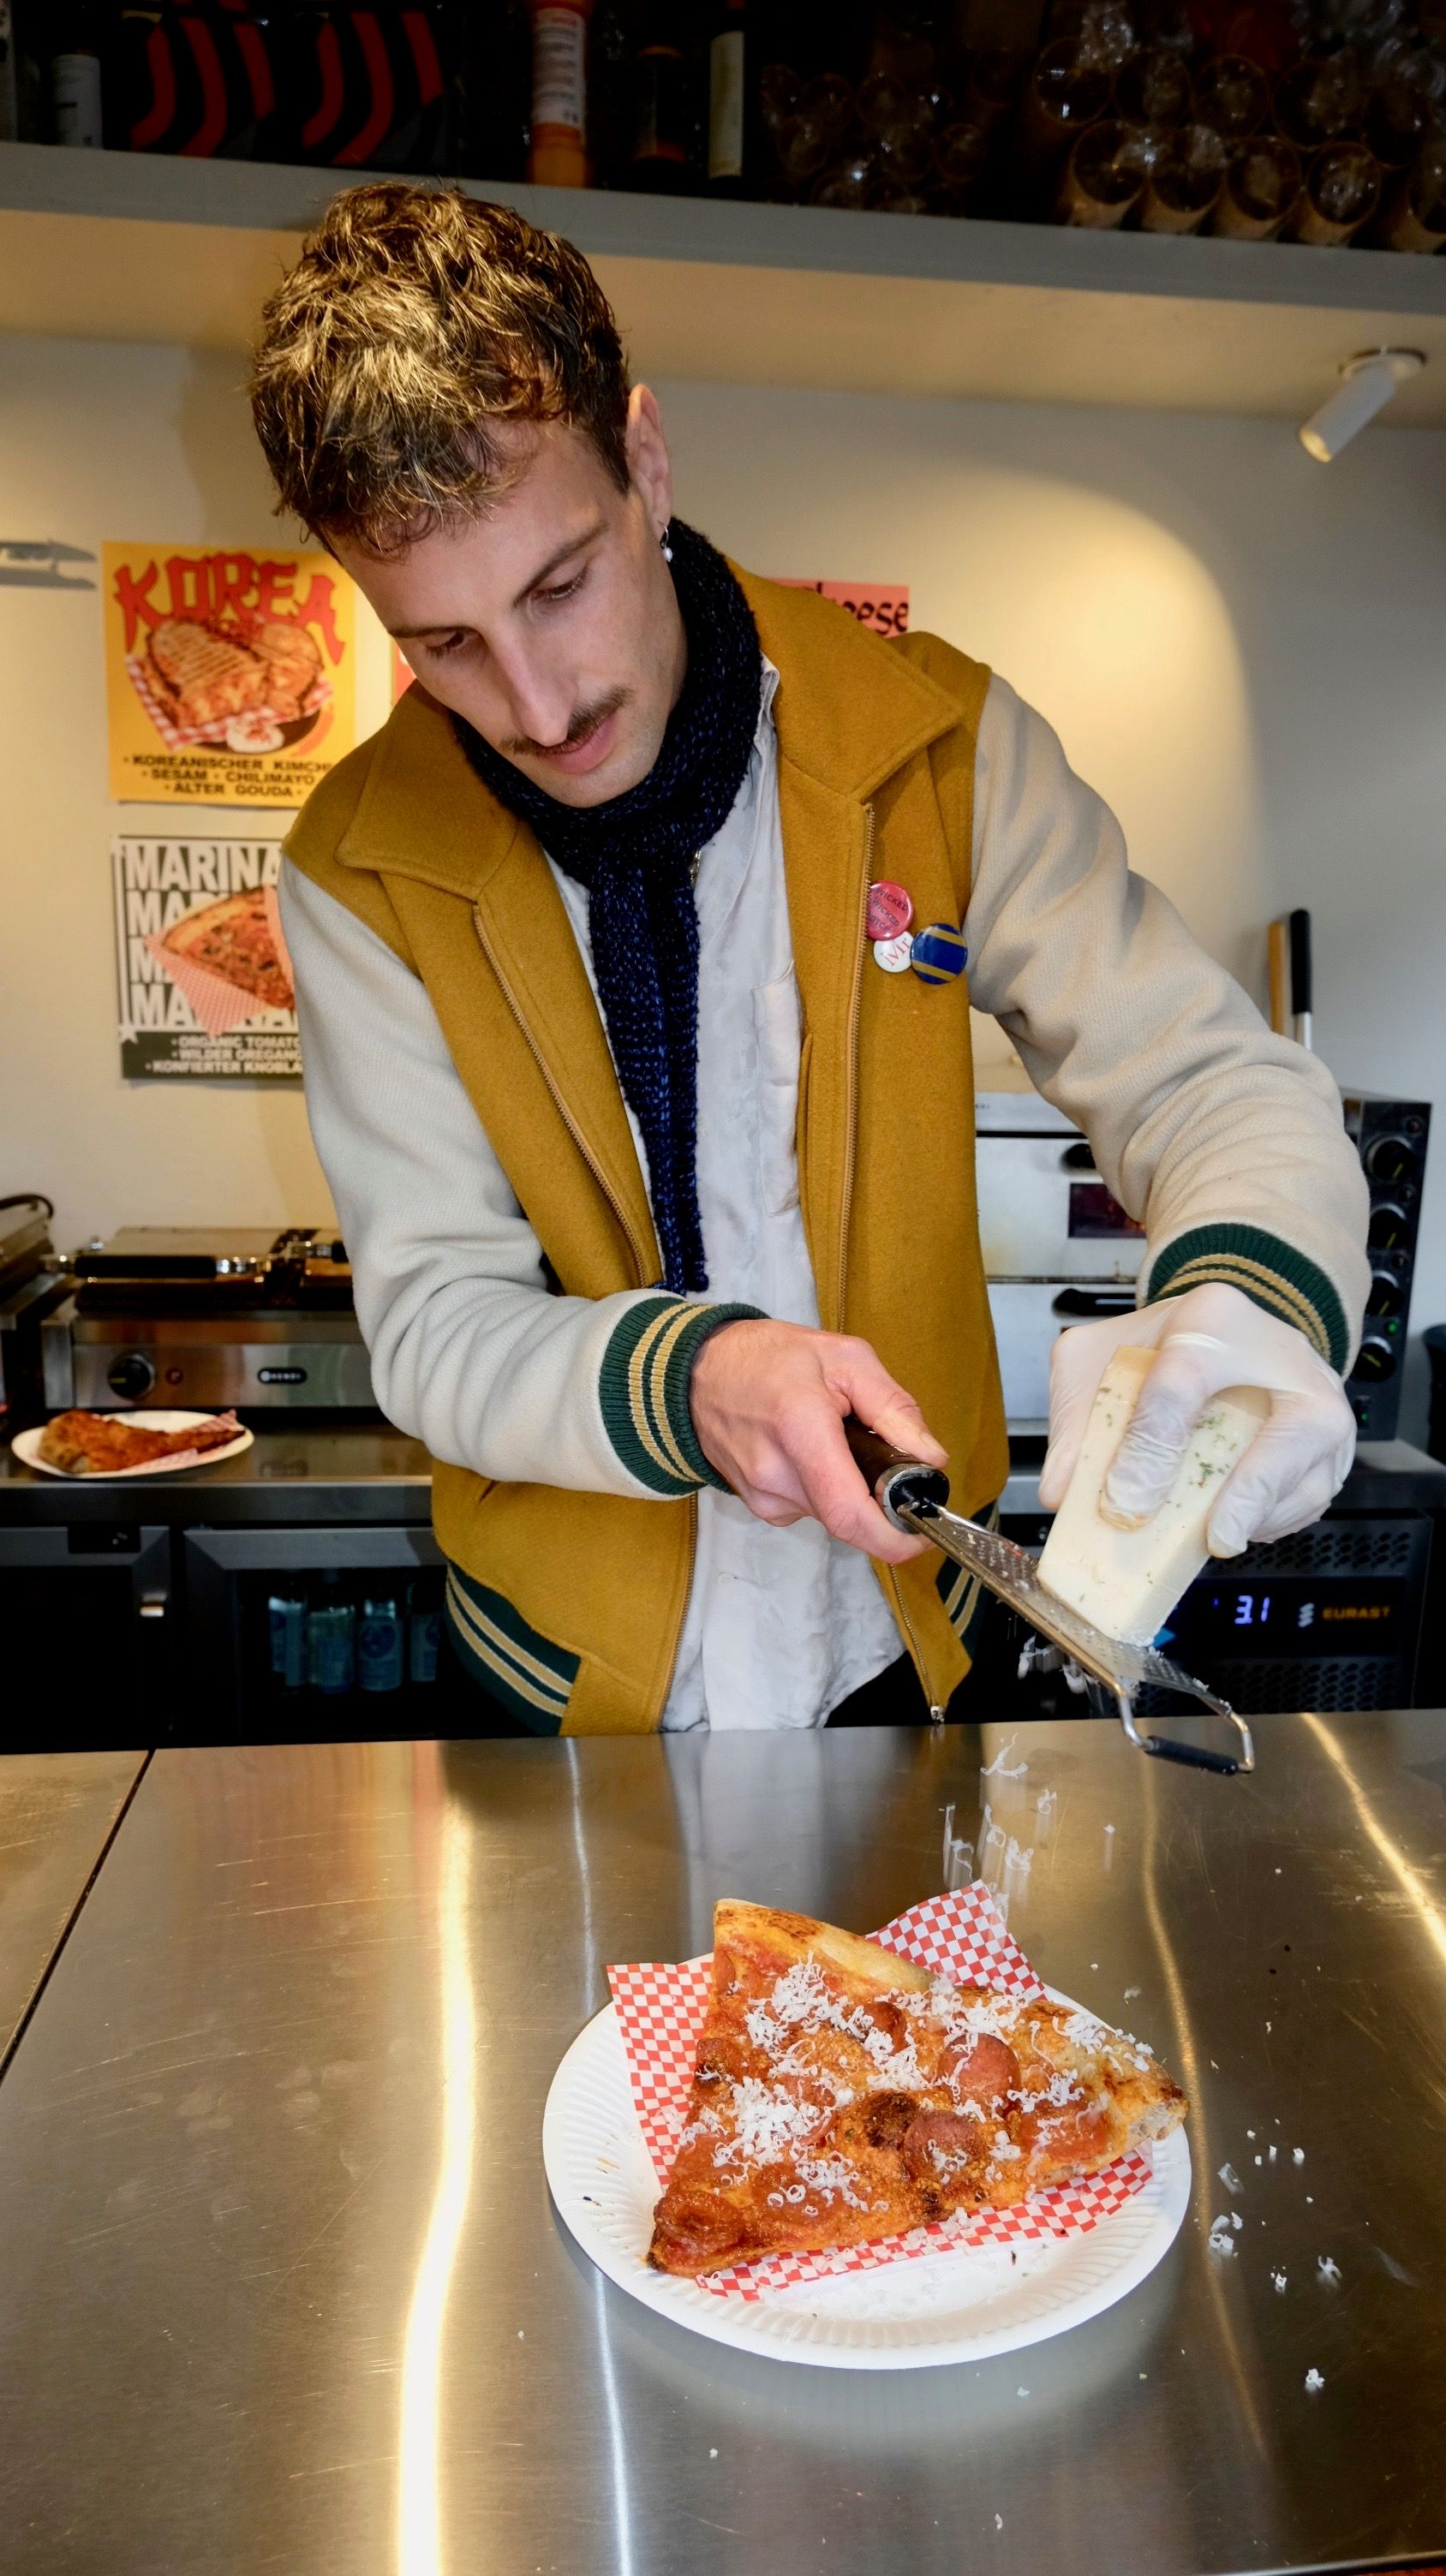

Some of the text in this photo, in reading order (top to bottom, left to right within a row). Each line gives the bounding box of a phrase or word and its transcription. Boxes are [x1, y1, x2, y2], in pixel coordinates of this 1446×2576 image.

[114, 552, 346, 666] KOREA
[133, 755, 263, 770] KOREANISCHER
[151, 769, 207, 781] SESAM
[174, 783, 293, 797] ALTER GOUDA
[178, 1035, 242, 1047] ORGANIC
[179, 1049, 232, 1060] WILDER
[1322, 1606, 1389, 1620] EURAST
